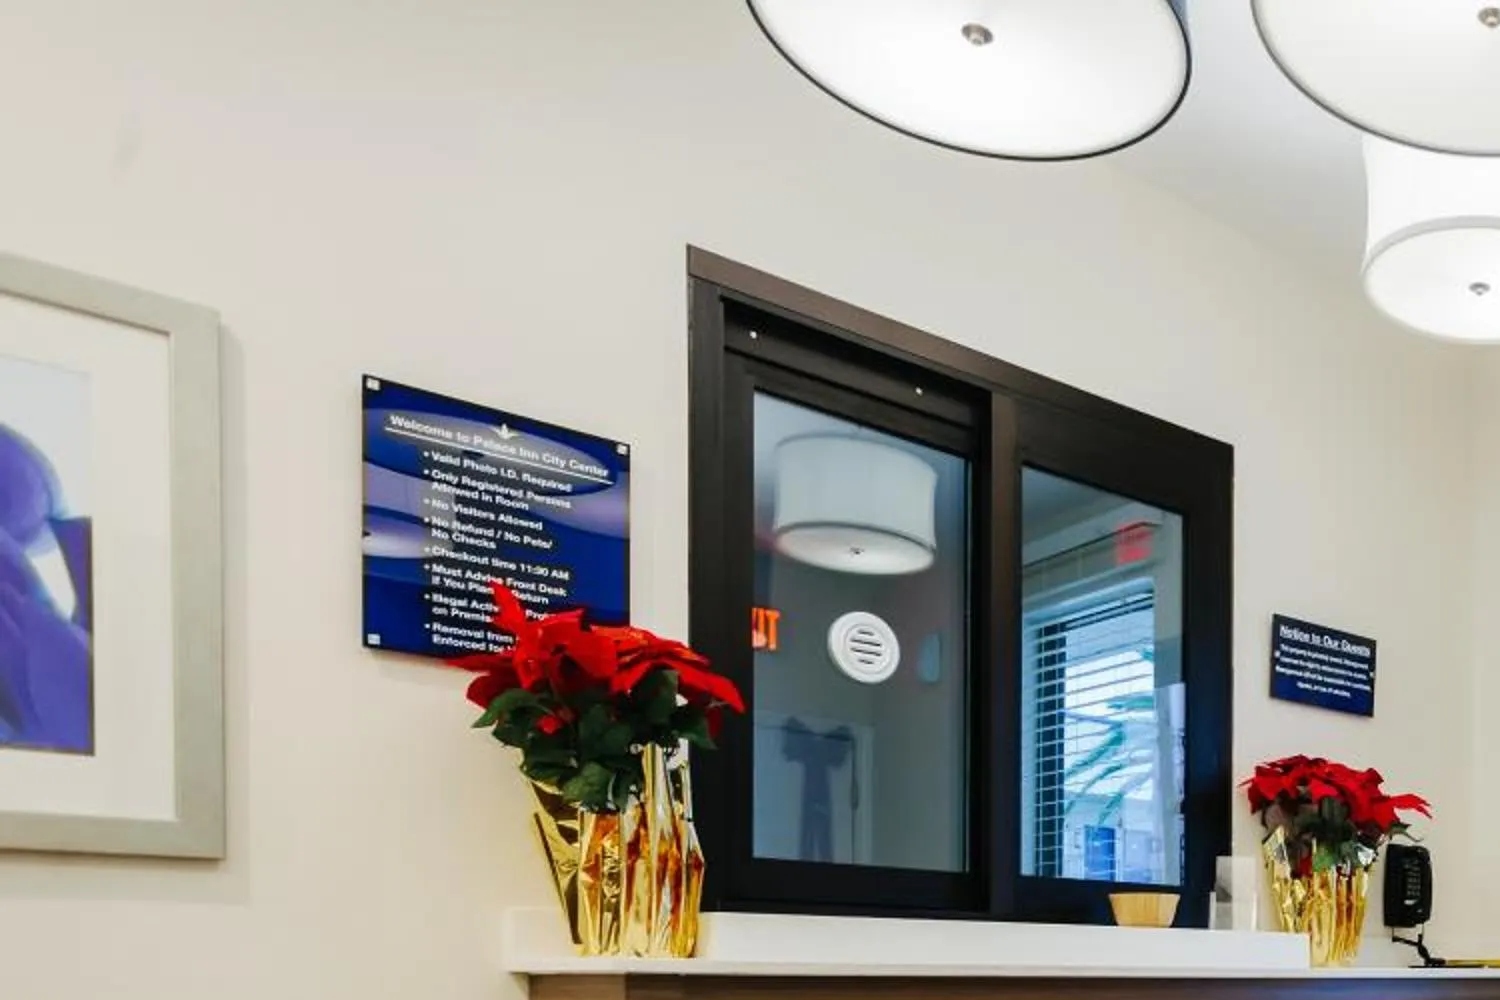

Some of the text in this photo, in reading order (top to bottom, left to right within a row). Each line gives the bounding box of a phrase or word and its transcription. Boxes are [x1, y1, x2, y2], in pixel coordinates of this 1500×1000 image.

[389, 414, 610, 478] Welcome to Palace Inn City Center
[431, 451, 573, 493] Valid Photo I.D. Required
[431, 469, 572, 509] Only Registered Persons
[431, 482, 530, 511] Allowed in Room
[431, 499, 544, 531] No Visitors Allowed
[431, 516, 449, 529] No
[451, 520, 495, 538] Refund
[504, 532, 521, 543] No
[431, 529, 497, 550] No Checks
[432, 547, 489, 566] Checkout
[492, 557, 517, 571] time
[551, 569, 570, 581] AM
[432, 564, 567, 597] Must Advise Front Desk
[443, 578, 466, 591] You
[468, 583, 495, 595] Plan
[431, 594, 500, 613] Illegal Activ
[432, 606, 493, 624] on Premis
[432, 623, 513, 645] Removal from
[432, 635, 486, 651] Enforced
